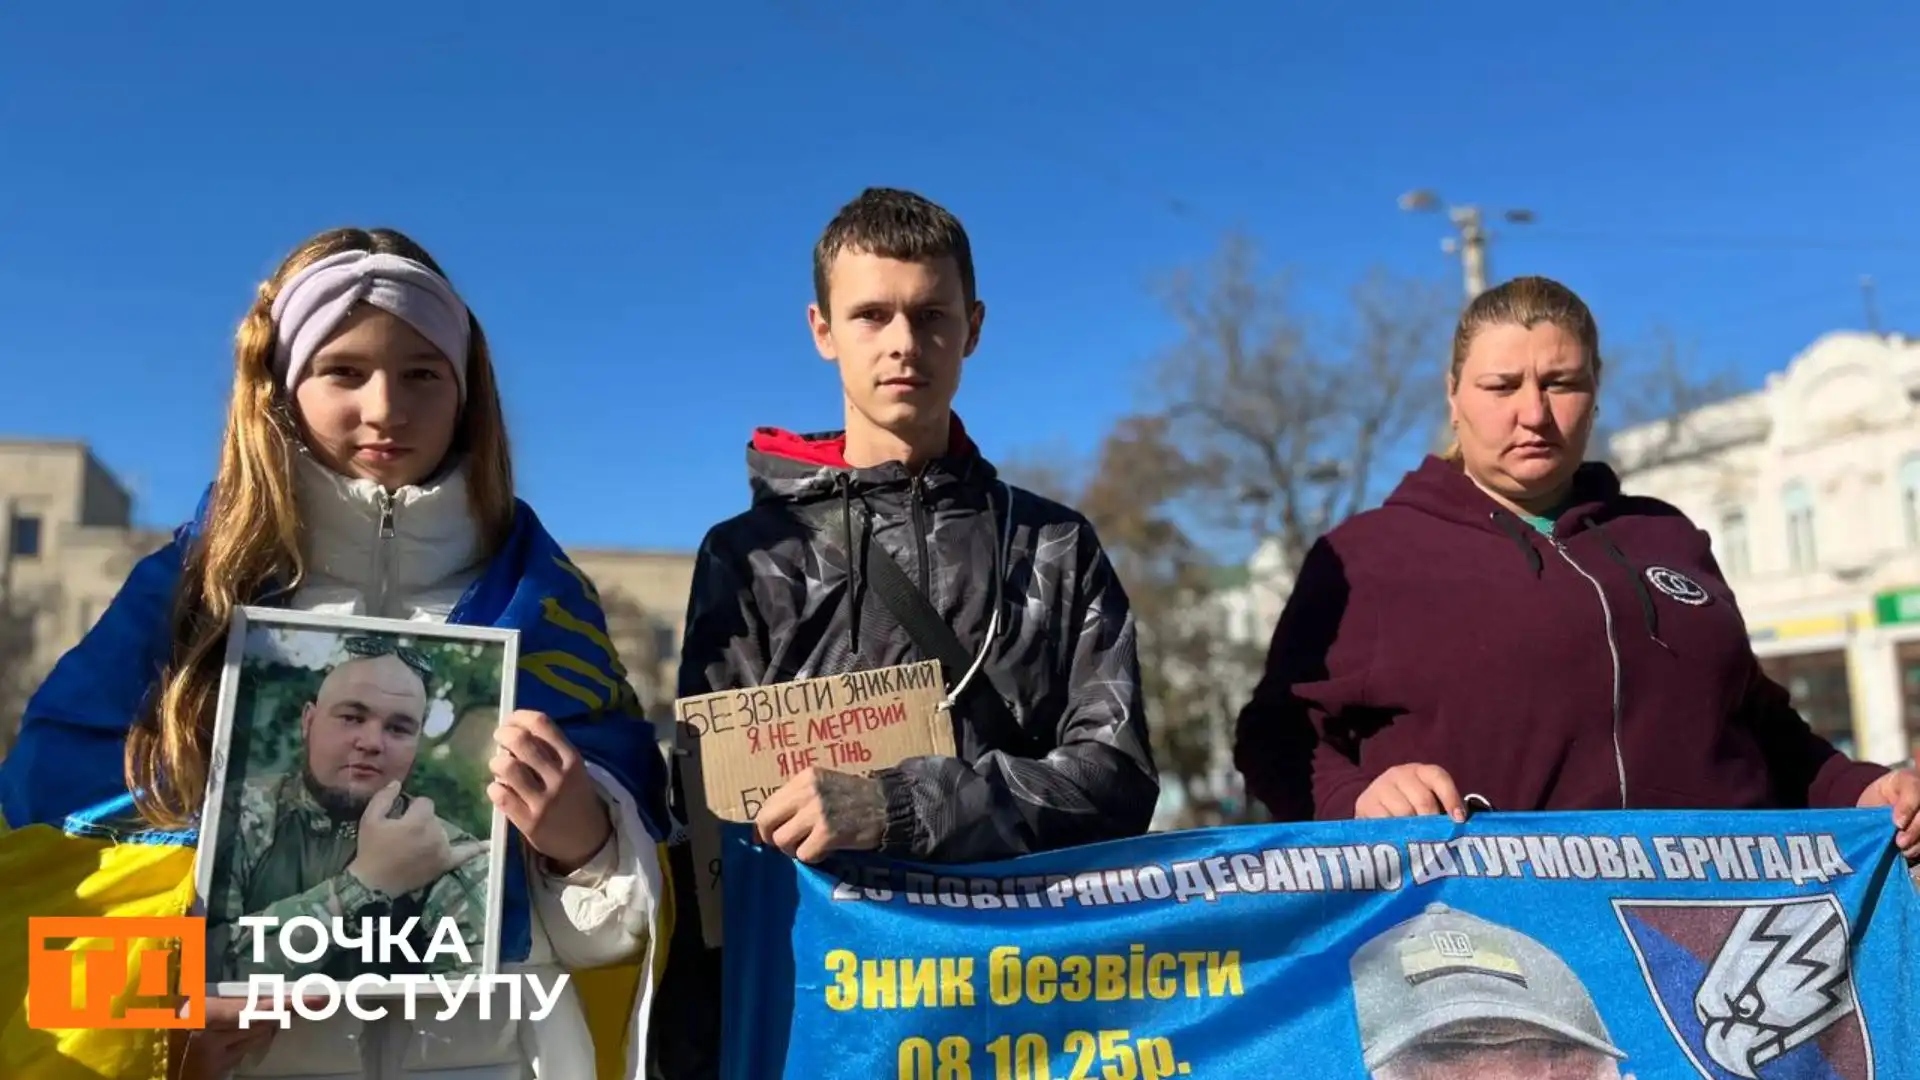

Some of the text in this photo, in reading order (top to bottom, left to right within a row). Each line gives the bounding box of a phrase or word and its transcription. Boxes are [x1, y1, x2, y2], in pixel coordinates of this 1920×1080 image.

[683, 663, 937, 739] БЕЗВІСТИ ЗНИКЛИЙ
[746, 698, 908, 754] Я НЕ МЕРТВИЙ
[824, 739, 872, 768] ТІНЬ
[832, 865, 894, 902] 25
[1408, 834, 1659, 885] ШТУРМОВА
[1653, 834, 1855, 886] БРИГАДА
[824, 943, 1245, 1012] Зник безвісти
